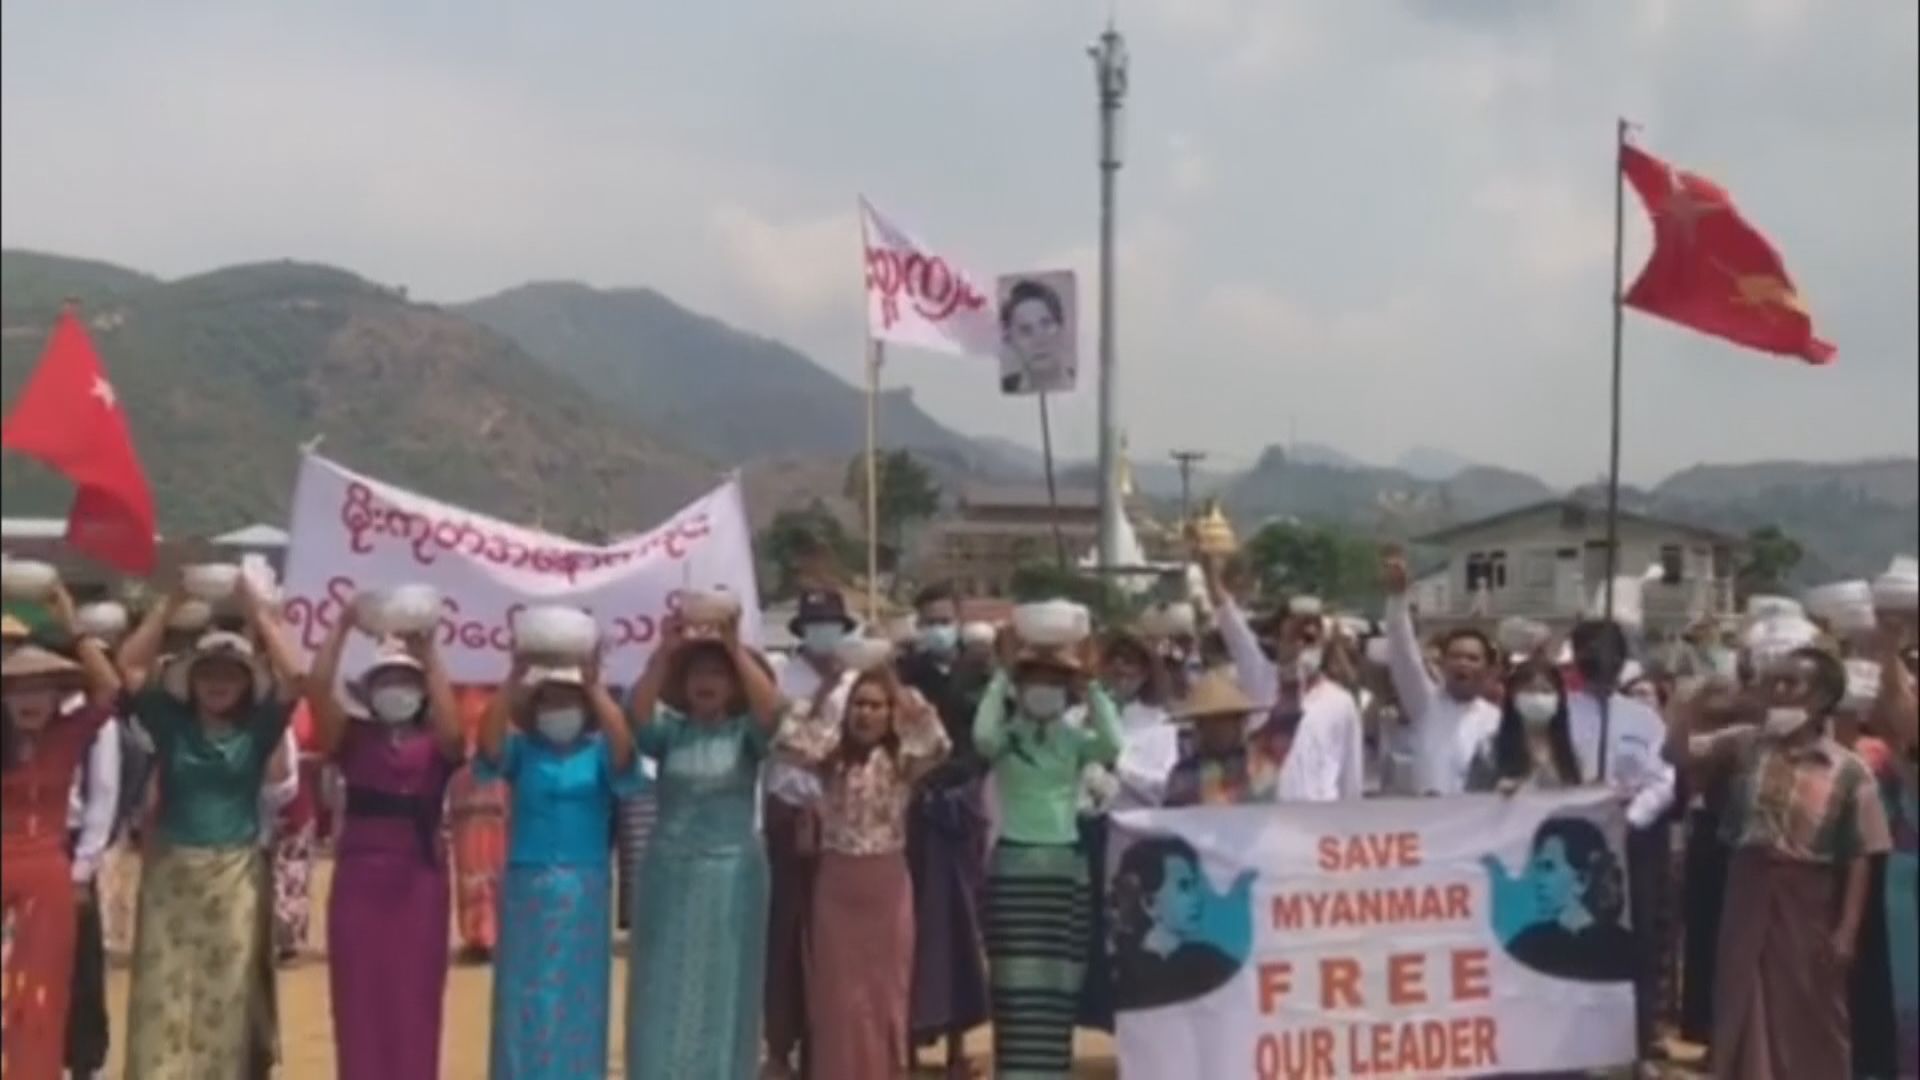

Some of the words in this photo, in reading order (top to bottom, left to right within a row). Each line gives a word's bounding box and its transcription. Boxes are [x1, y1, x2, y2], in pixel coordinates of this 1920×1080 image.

[1317, 831, 1422, 871] SAVE
[1271, 883, 1473, 930] MYANMAR
[1257, 948, 1491, 1016] FREE
[1255, 1027, 1336, 1080] OUR
[1349, 1016, 1500, 1075] LEADER
